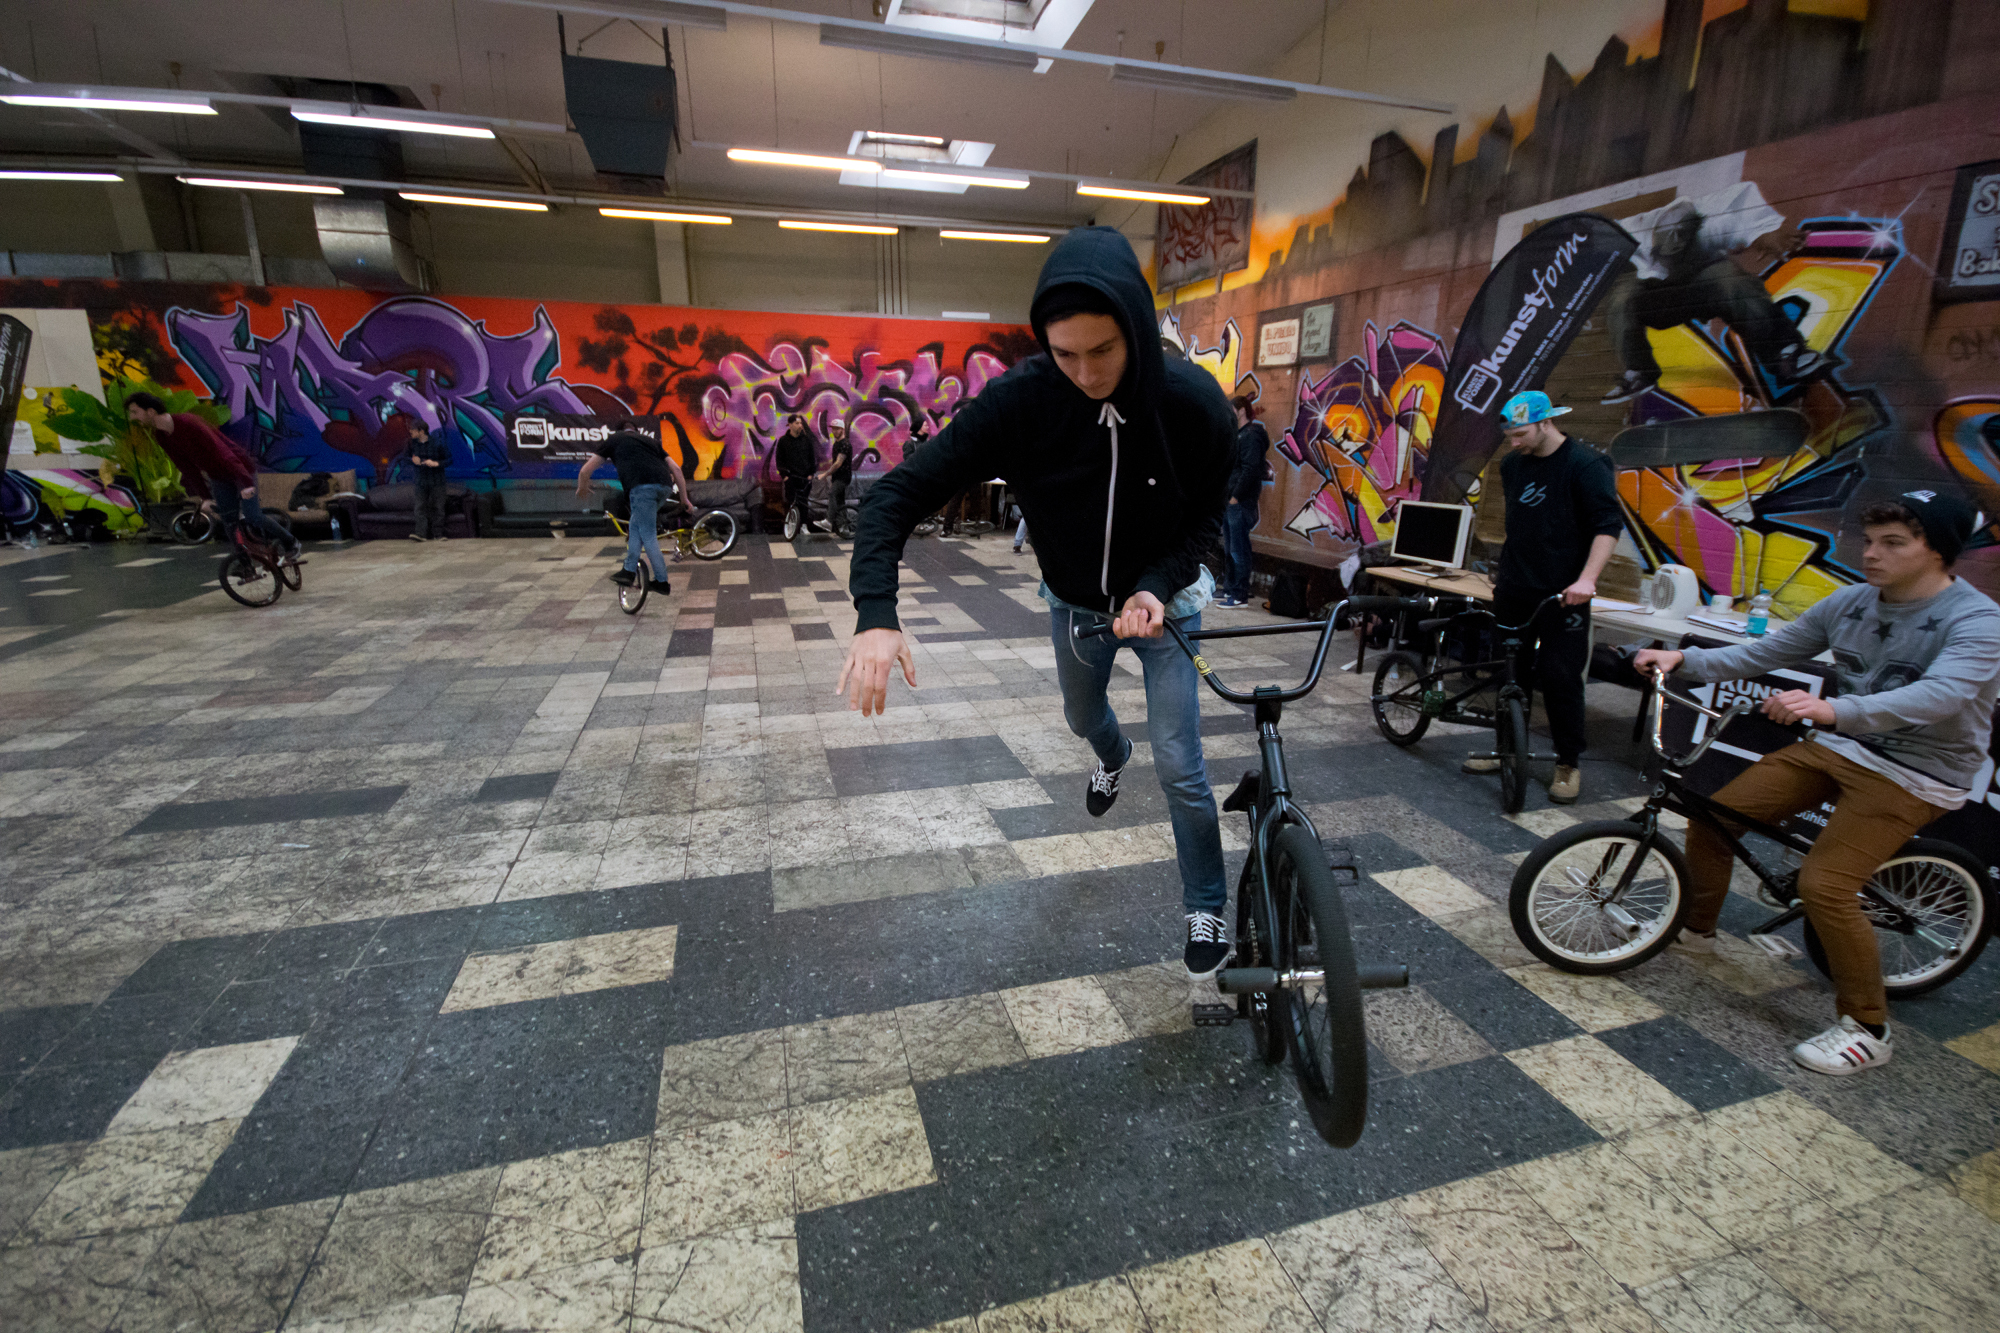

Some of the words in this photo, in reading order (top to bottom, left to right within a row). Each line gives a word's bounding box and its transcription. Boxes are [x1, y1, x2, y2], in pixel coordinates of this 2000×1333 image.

[1479, 233, 1588, 373] kunstform
[1535, 339, 1549, 357] BMX
[1461, 371, 1481, 400] KUNST
[1469, 374, 1488, 402] FORM
